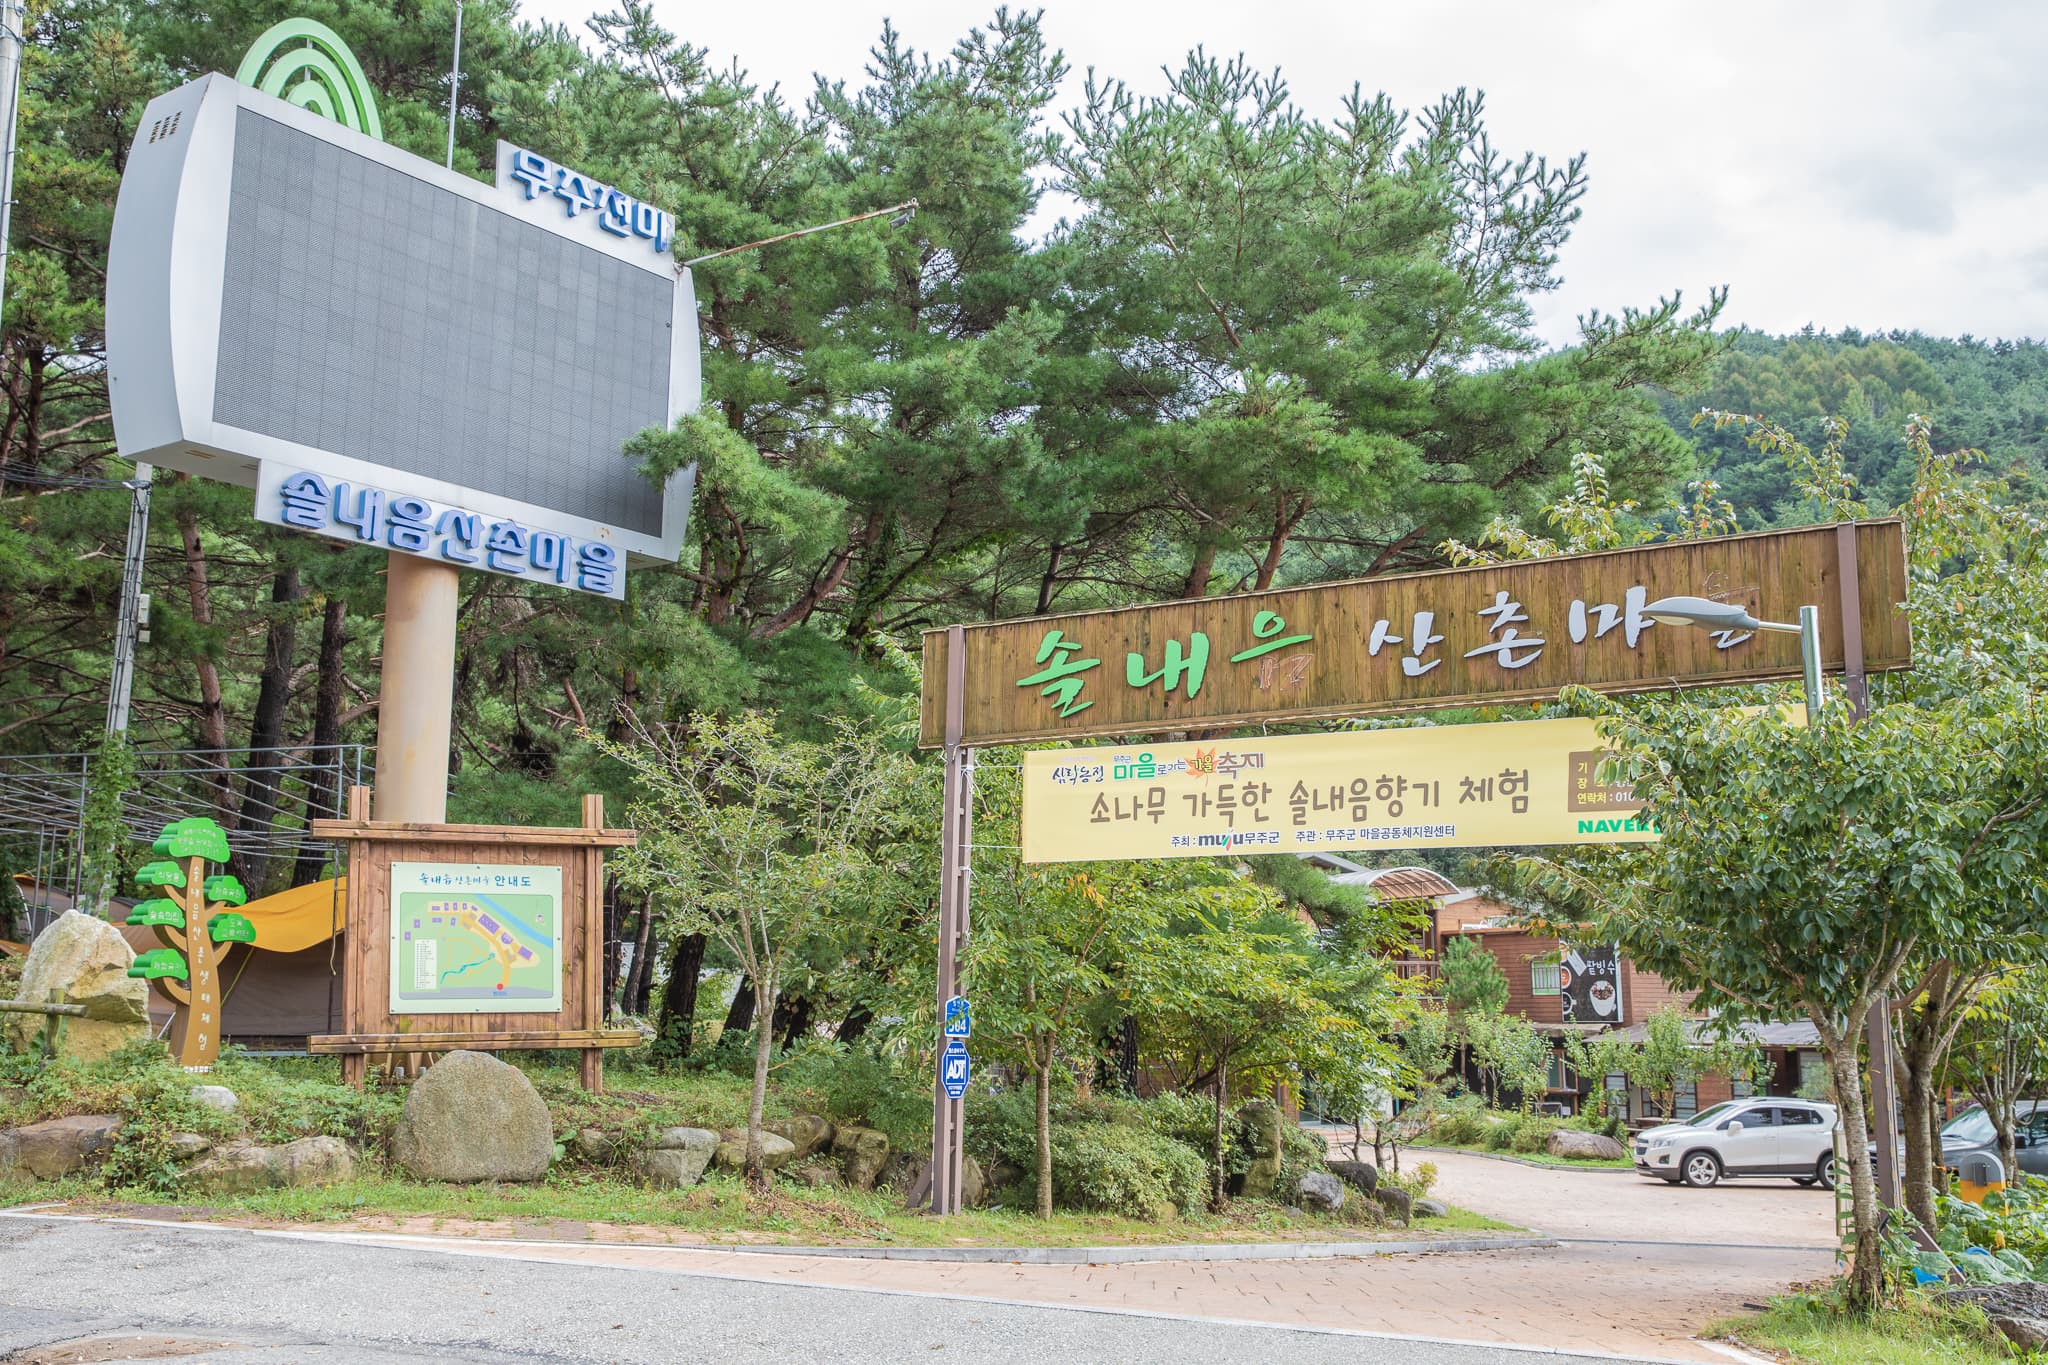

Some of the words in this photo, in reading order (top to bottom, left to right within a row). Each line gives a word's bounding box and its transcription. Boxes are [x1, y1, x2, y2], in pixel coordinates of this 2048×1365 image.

[280, 471, 618, 593] 솔내음산촌마을
[1191, 754, 1213, 773] 가을
[1217, 751, 1264, 780] 축제
[1089, 787, 1165, 824] 소나무
[1182, 781, 1272, 827] 가득한
[1288, 774, 1439, 826] 솔내음향기
[1458, 768, 1529, 814] 체험
[1325, 829, 1356, 841] 무주군
[1360, 824, 1455, 840] 마을공동체지원센터
[494, 875, 532, 887] 안내도
[946, 1059, 966, 1079] ADT
